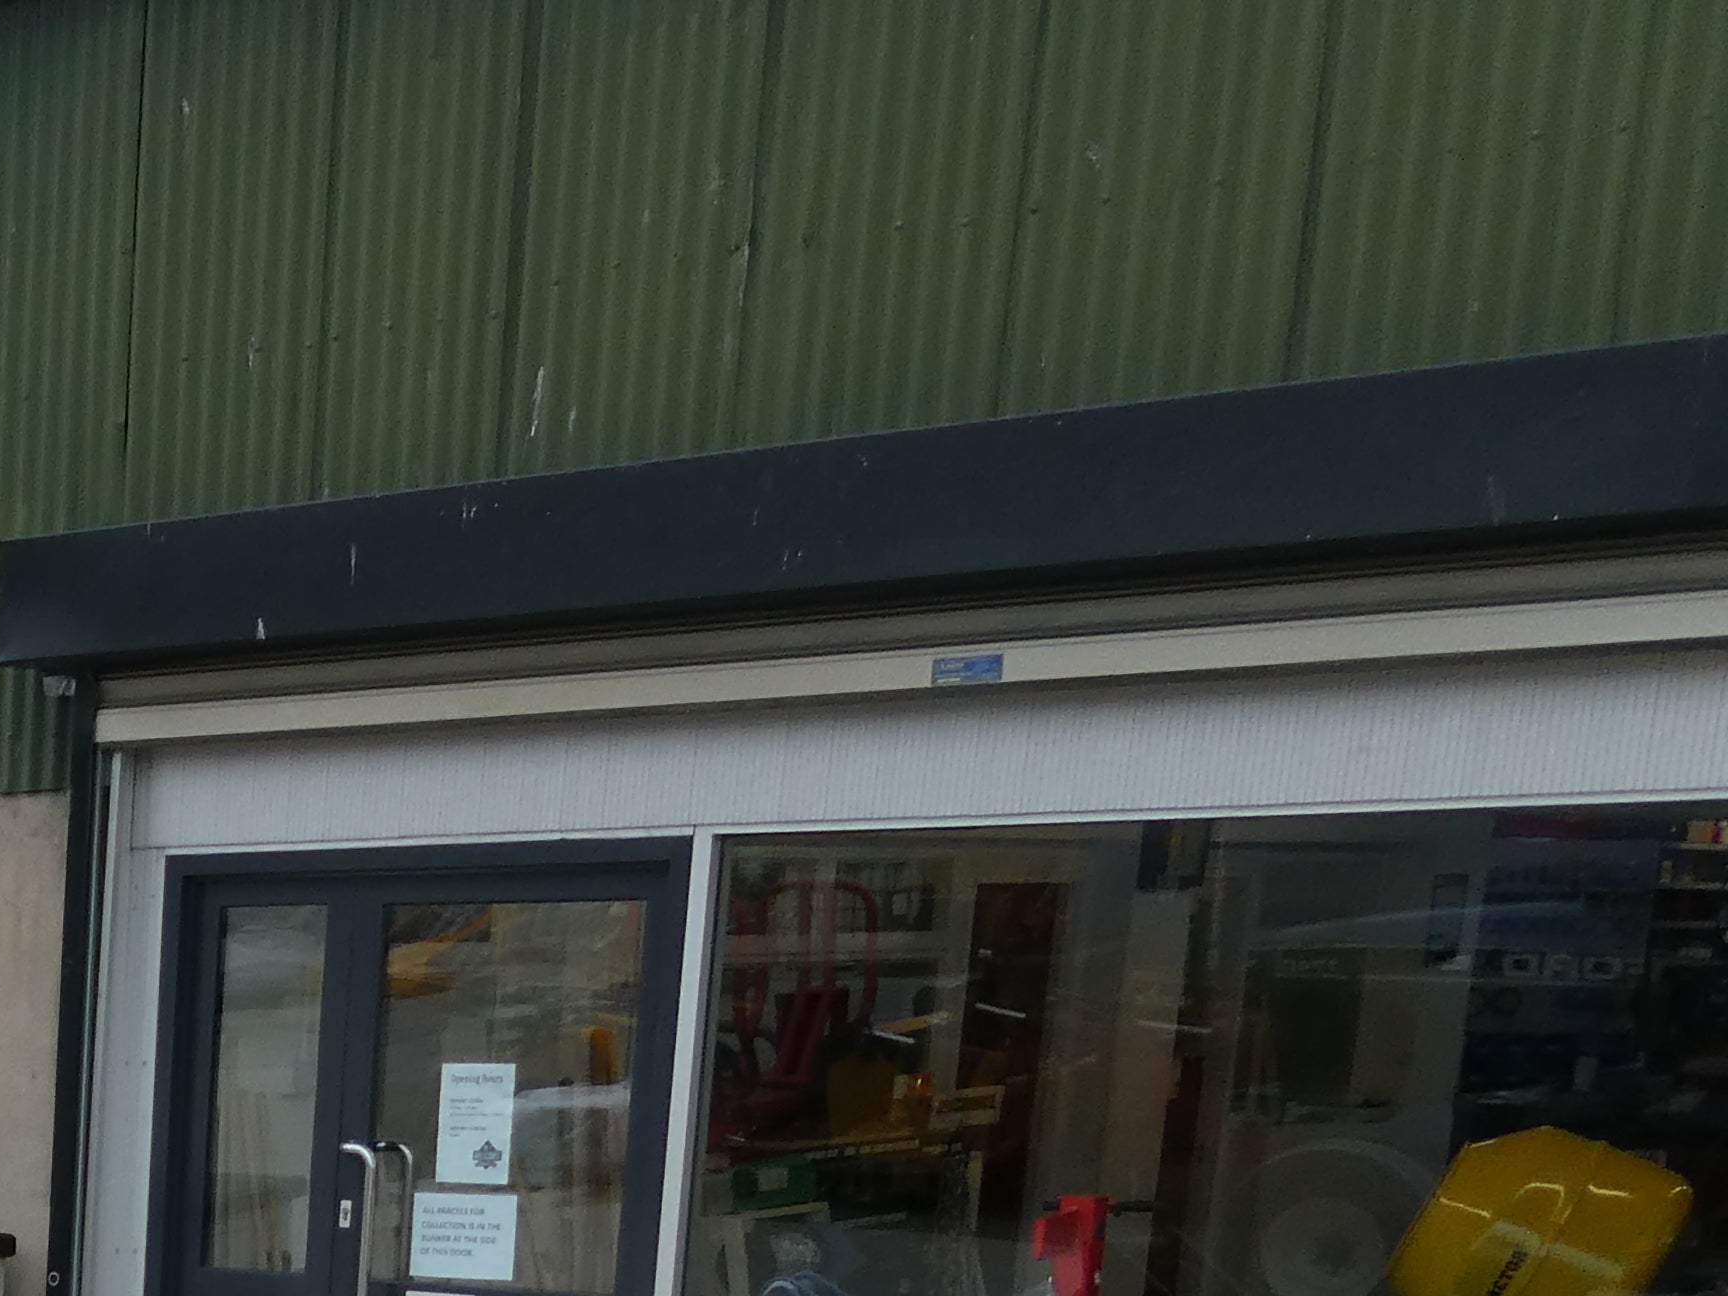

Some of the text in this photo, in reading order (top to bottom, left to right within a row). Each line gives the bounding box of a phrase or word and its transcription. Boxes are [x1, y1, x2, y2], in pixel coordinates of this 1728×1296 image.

[451, 1073, 480, 1086] Opening
[421, 1221, 466, 1231] COLLECTION
[487, 1223, 502, 1231] THE
[464, 1236, 478, 1245] THE
